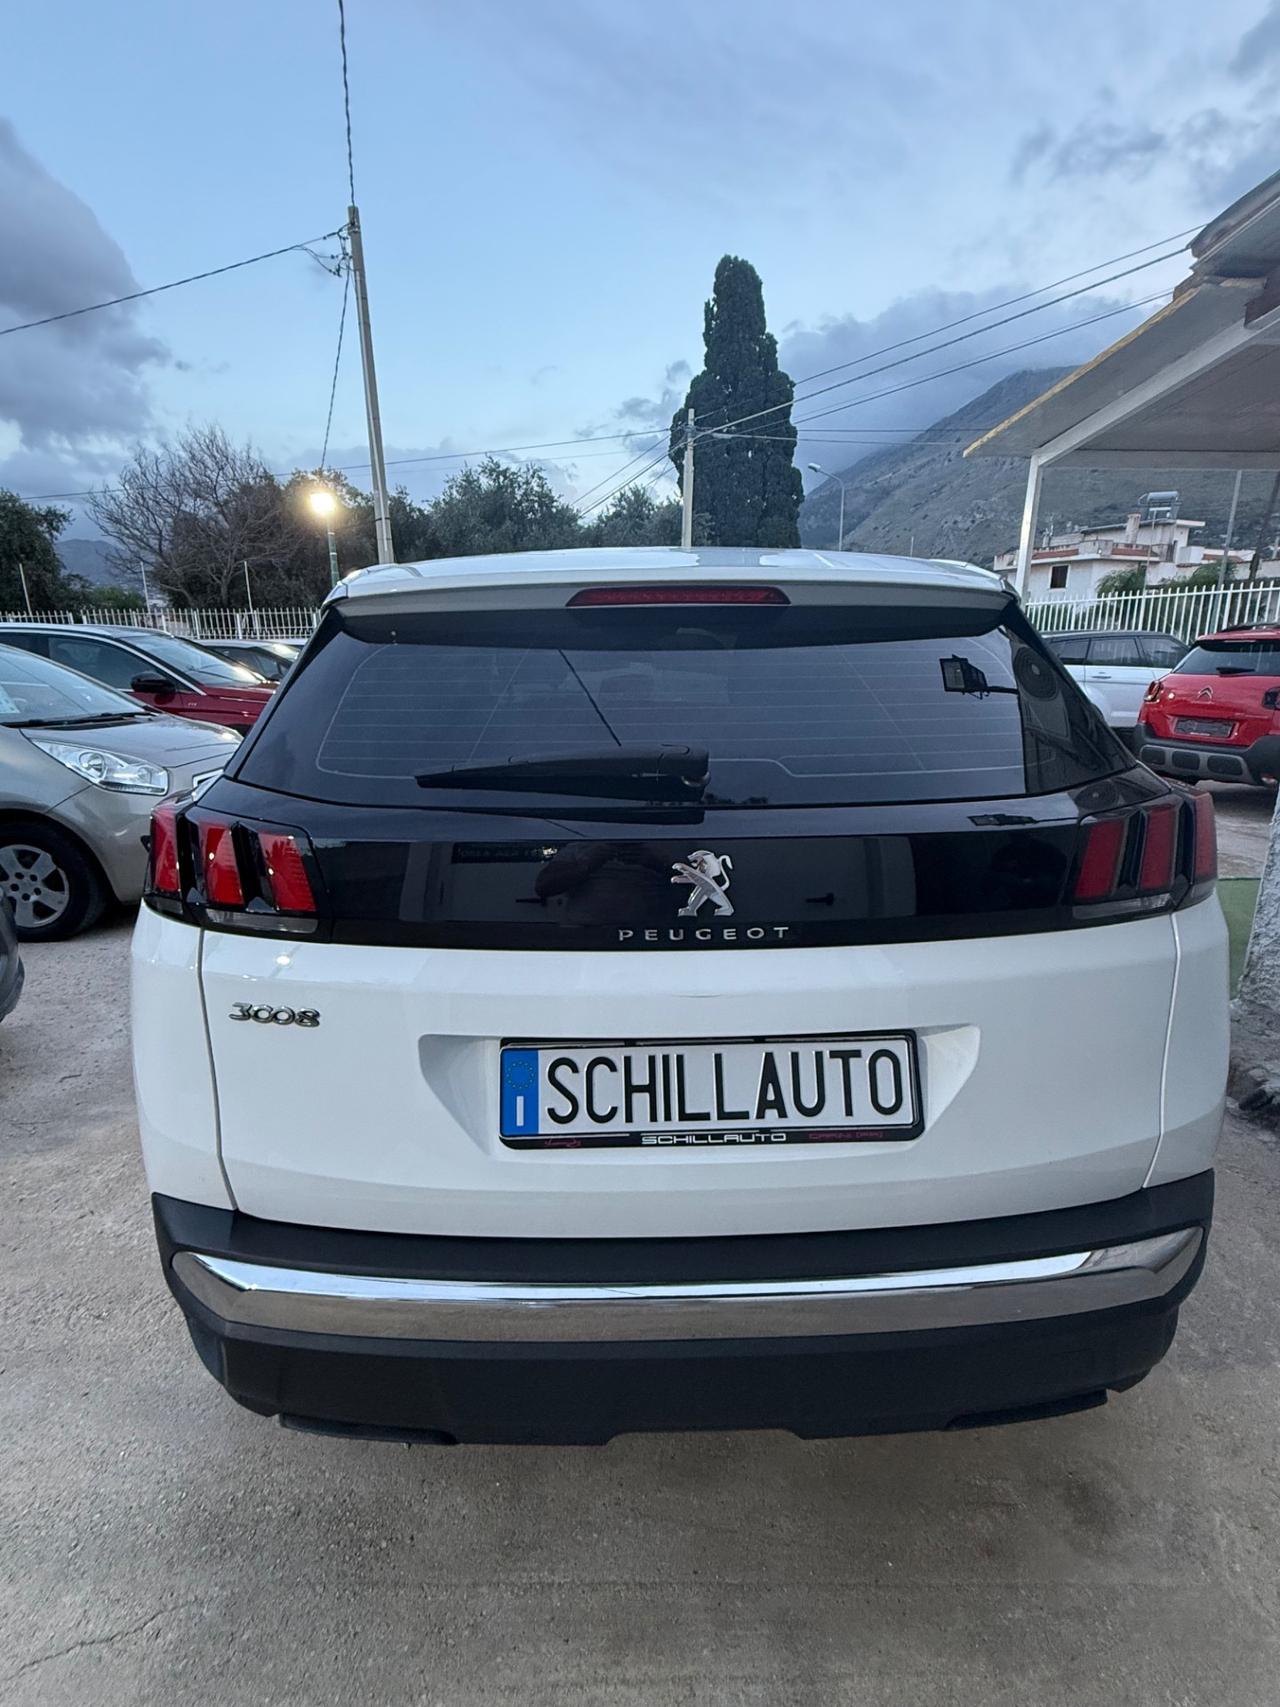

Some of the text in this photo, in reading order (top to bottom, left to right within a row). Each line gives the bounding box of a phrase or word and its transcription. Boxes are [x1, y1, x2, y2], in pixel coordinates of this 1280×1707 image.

[618, 927, 789, 941] PEUGEOT
[229, 1002, 320, 1027] 3008
[546, 1048, 904, 1125] SCHILLAUTO
[516, 1096, 524, 1127] I
[641, 1132, 787, 1145] SCHILLAUTO
